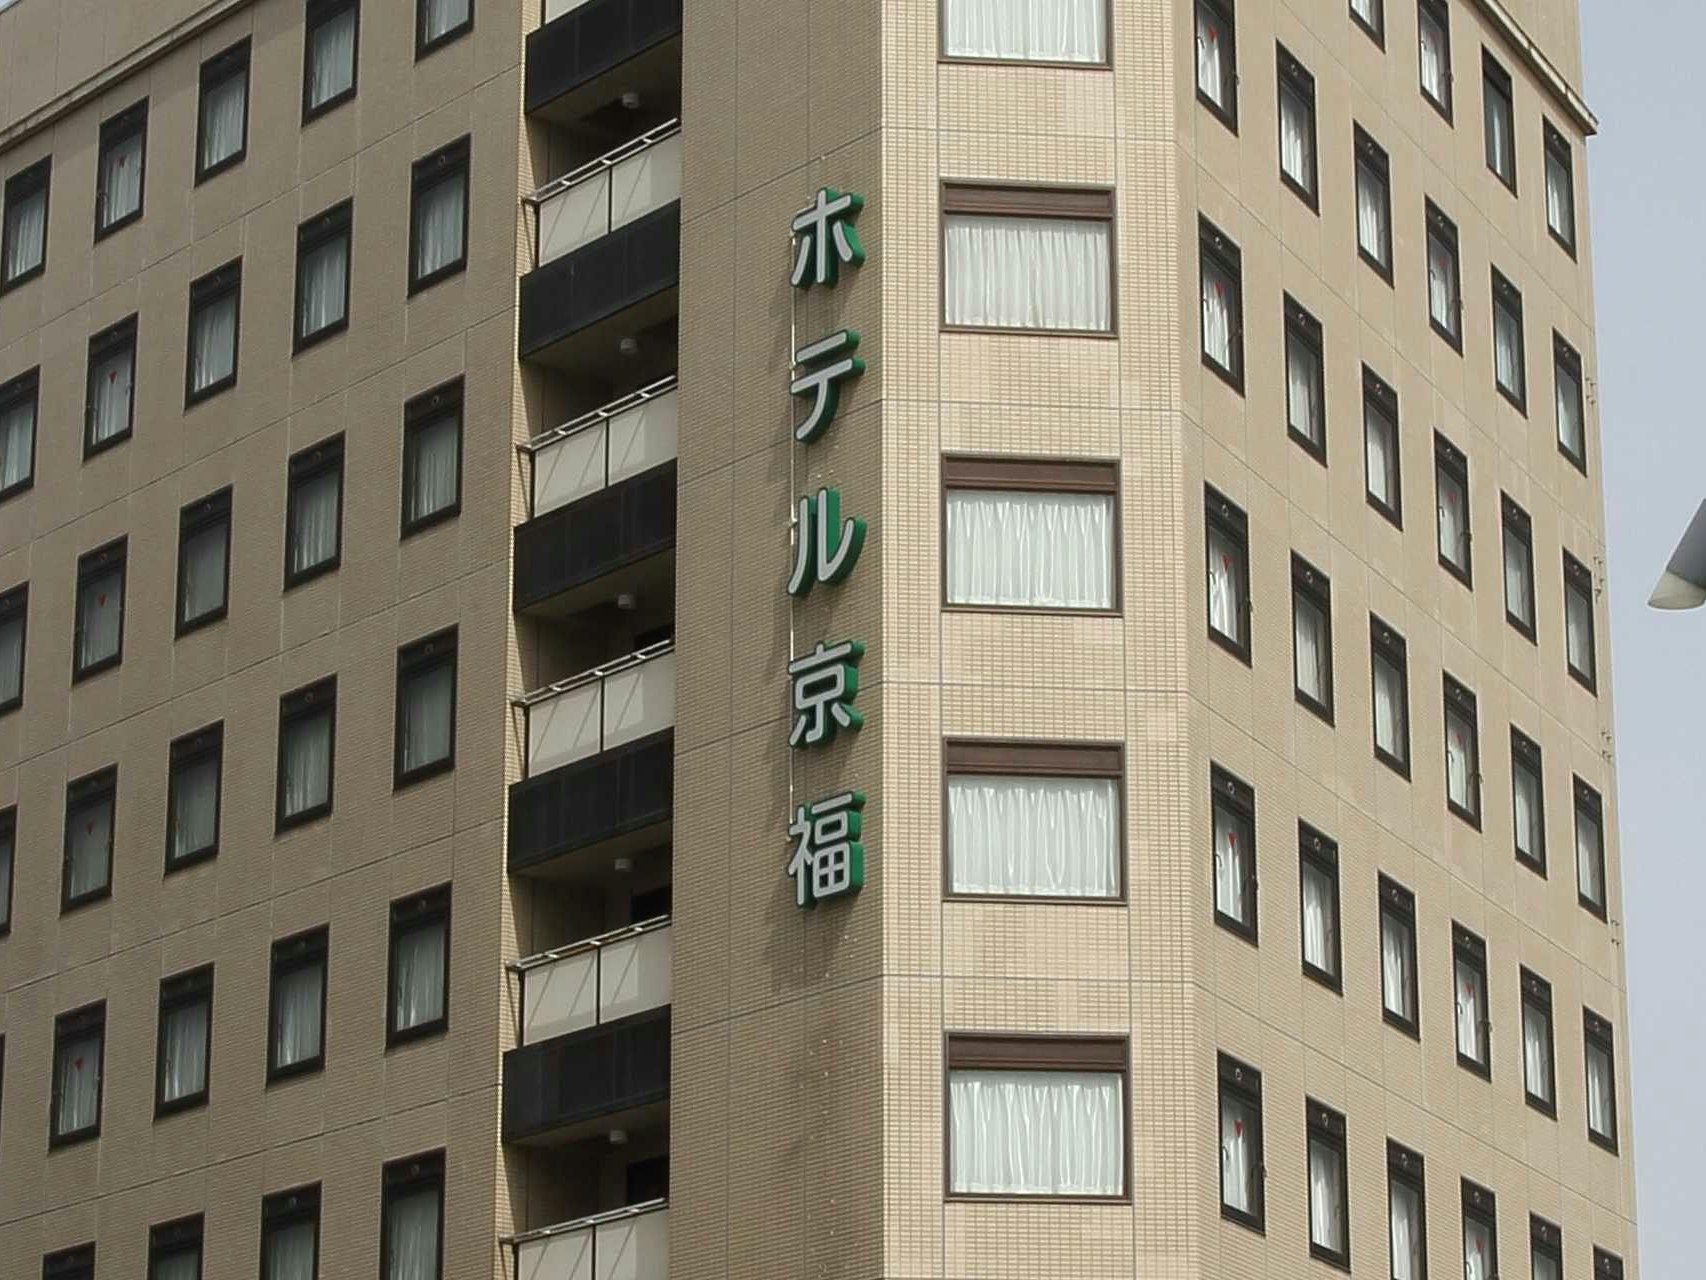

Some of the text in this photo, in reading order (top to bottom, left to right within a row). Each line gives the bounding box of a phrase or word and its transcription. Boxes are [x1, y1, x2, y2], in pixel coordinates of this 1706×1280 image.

[788, 187, 866, 908] ホテル京福
